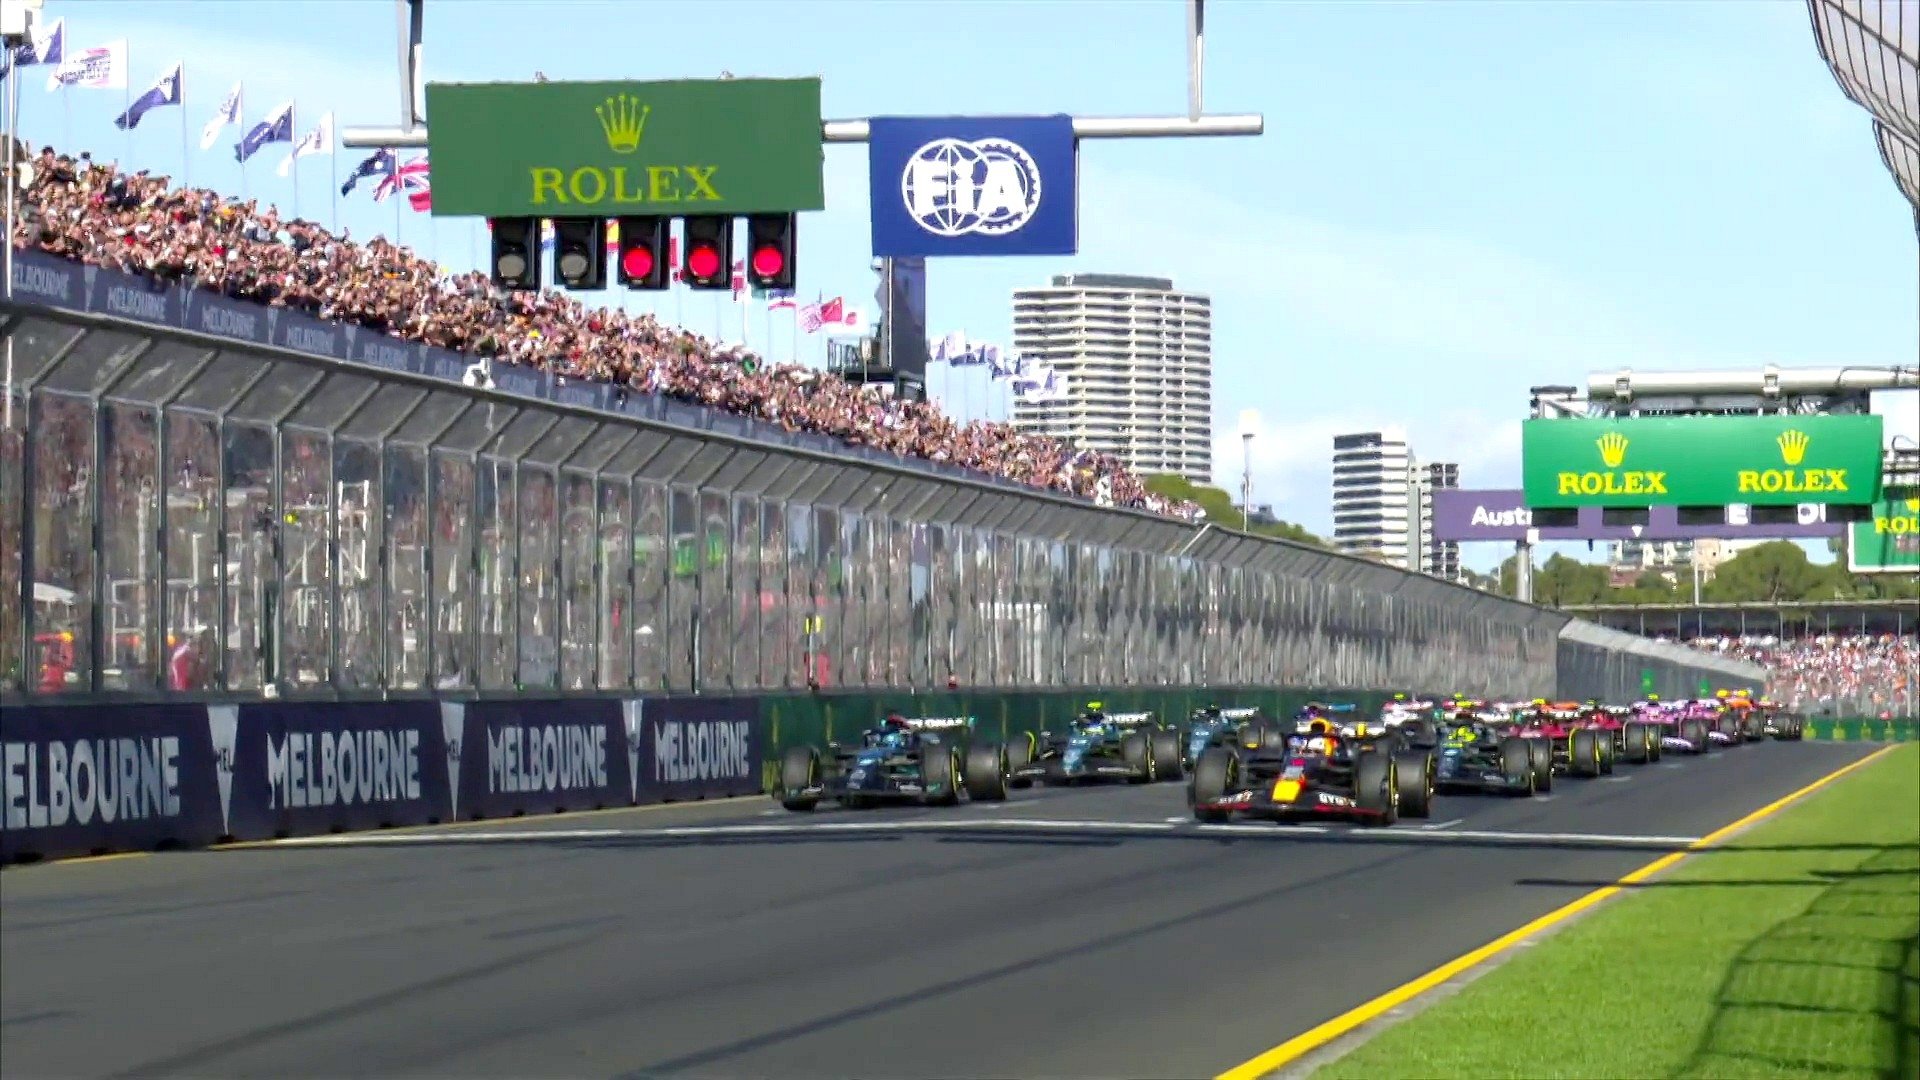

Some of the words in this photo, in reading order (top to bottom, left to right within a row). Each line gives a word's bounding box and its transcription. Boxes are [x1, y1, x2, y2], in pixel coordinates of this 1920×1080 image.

[531, 165, 725, 205] ROLEX
[1558, 472, 1668, 496] ROLEX
[1738, 469, 1848, 493] ROLEX
[266, 729, 421, 809] MELBOURNE
[487, 725, 608, 793] MELBOURNE
[654, 720, 750, 782] MELBOURNE
[0, 736, 180, 831] ELBOURNE
